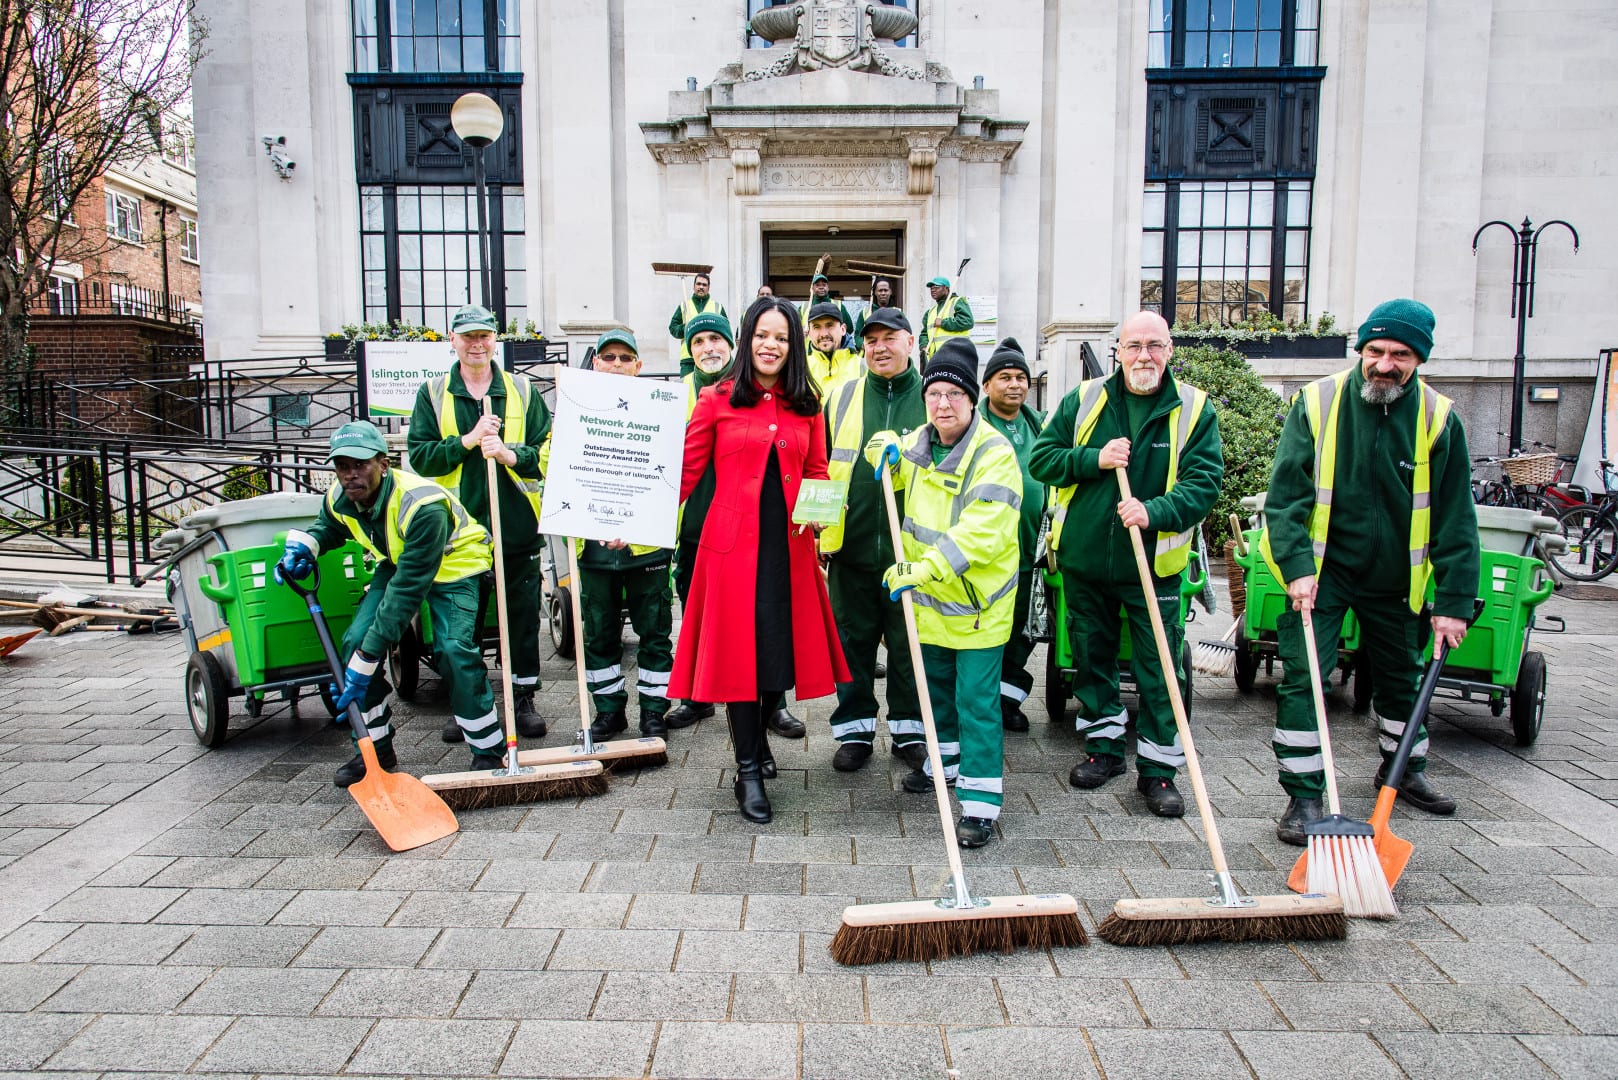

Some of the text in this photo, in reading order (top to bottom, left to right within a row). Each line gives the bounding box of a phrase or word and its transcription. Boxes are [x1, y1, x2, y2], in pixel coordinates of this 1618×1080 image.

[371, 368, 419, 380] Islington
[579, 414, 660, 433] Network Award
[586, 427, 652, 443] Winner 2019
[583, 450, 611, 460] Delivery
[611, 454, 633, 462] Award
[584, 443, 650, 457] Outstanding Service
[569, 464, 594, 472] London
[595, 467, 623, 476] Borough
[632, 472, 660, 481] Islington
